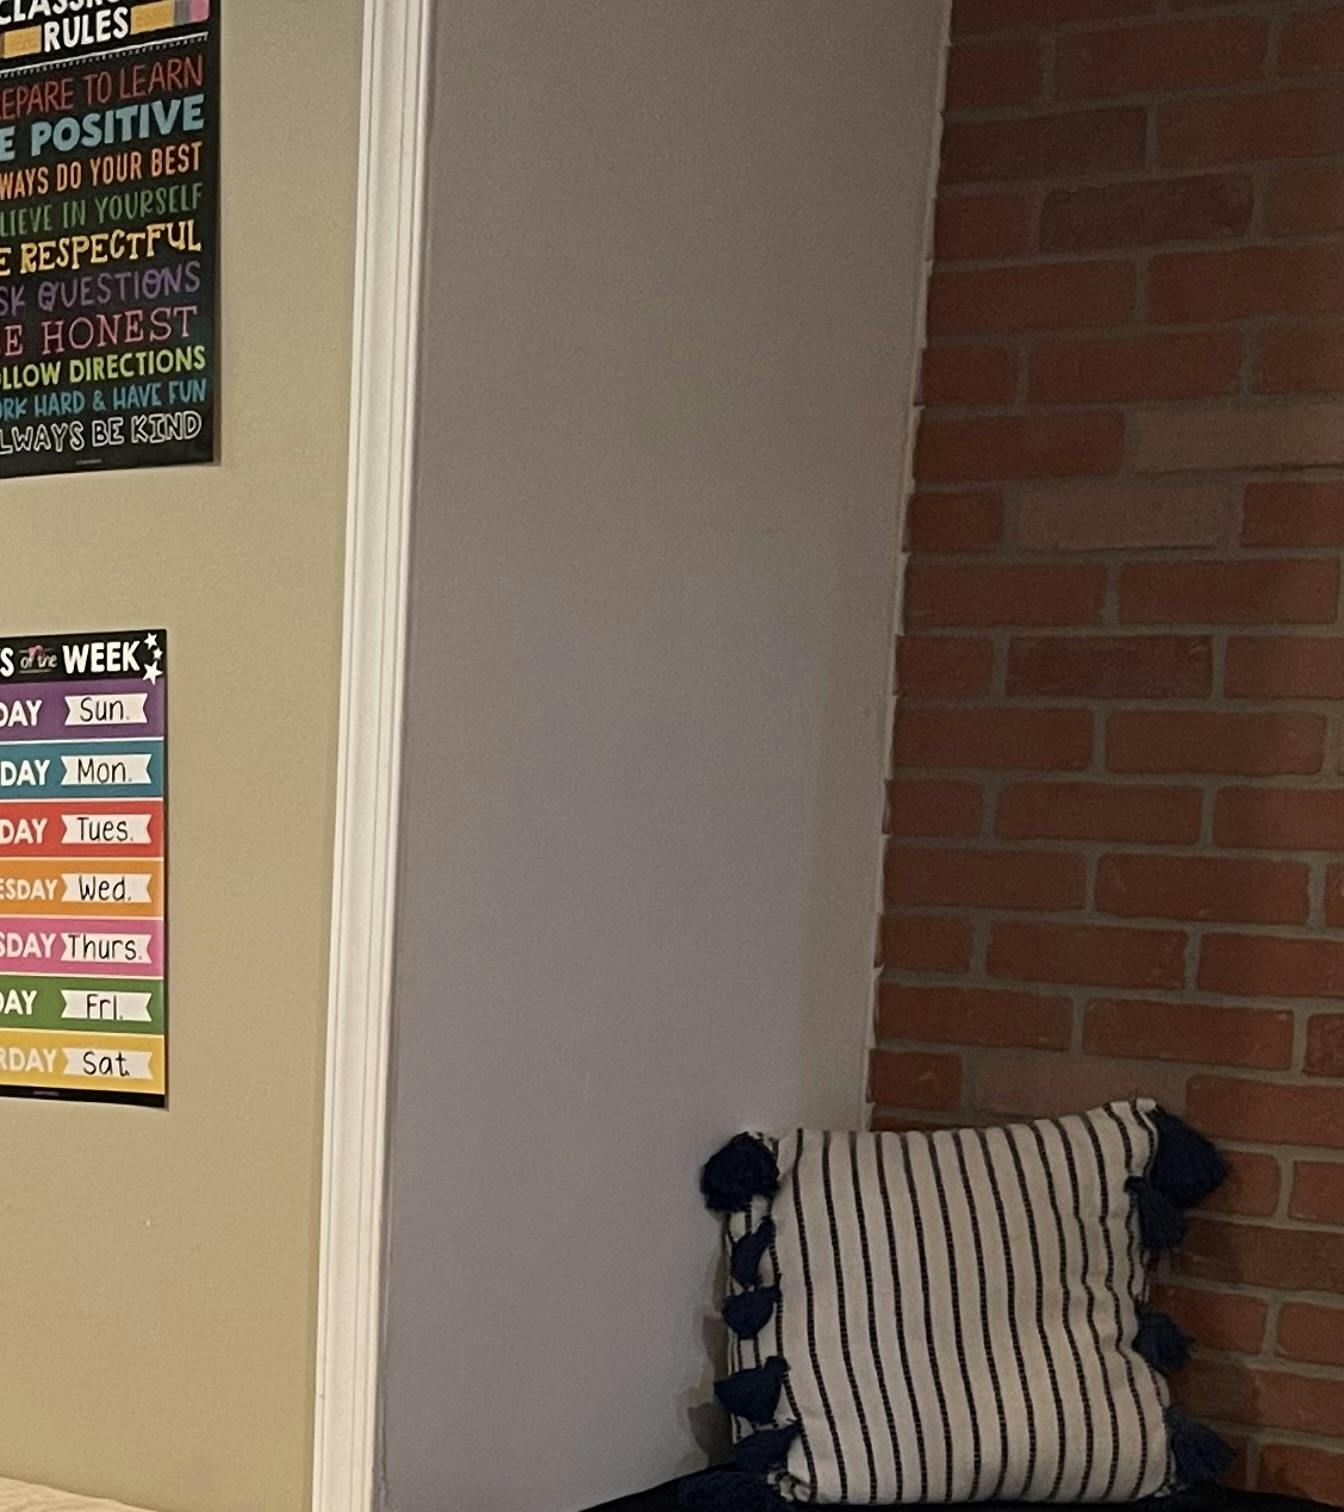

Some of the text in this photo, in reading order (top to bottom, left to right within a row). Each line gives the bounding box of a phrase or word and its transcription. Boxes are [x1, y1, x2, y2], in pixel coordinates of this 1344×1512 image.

[43, 6, 129, 53] RULES
[83, 71, 112, 104] TO
[119, 54, 203, 100] LEARN
[31, 94, 205, 157] POSITIVE
[56, 161, 82, 193] DO
[90, 151, 142, 187] YOUR
[151, 141, 203, 177] BEST
[63, 200, 86, 228] IN
[95, 183, 203, 225] YOURSELF
[20, 219, 201, 275] RESPECTFUL
[38, 260, 201, 312] QUESTIONS
[42, 305, 197, 355] HONEST
[69, 344, 206, 383] DIRECTIONS
[34, 390, 85, 417] HARD
[92, 390, 107, 411] &
[113, 383, 162, 410] HAVE
[168, 378, 207, 405] FUN
[92, 416, 124, 447] BE
[131, 410, 202, 444] KIND
[62, 640, 141, 674] WEEK
[79, 696, 130, 722] Sun.
[77, 758, 133, 784] Mon.
[77, 816, 134, 842] Tues.
[79, 875, 132, 901] Wed.
[68, 934, 142, 961] Thurs.
